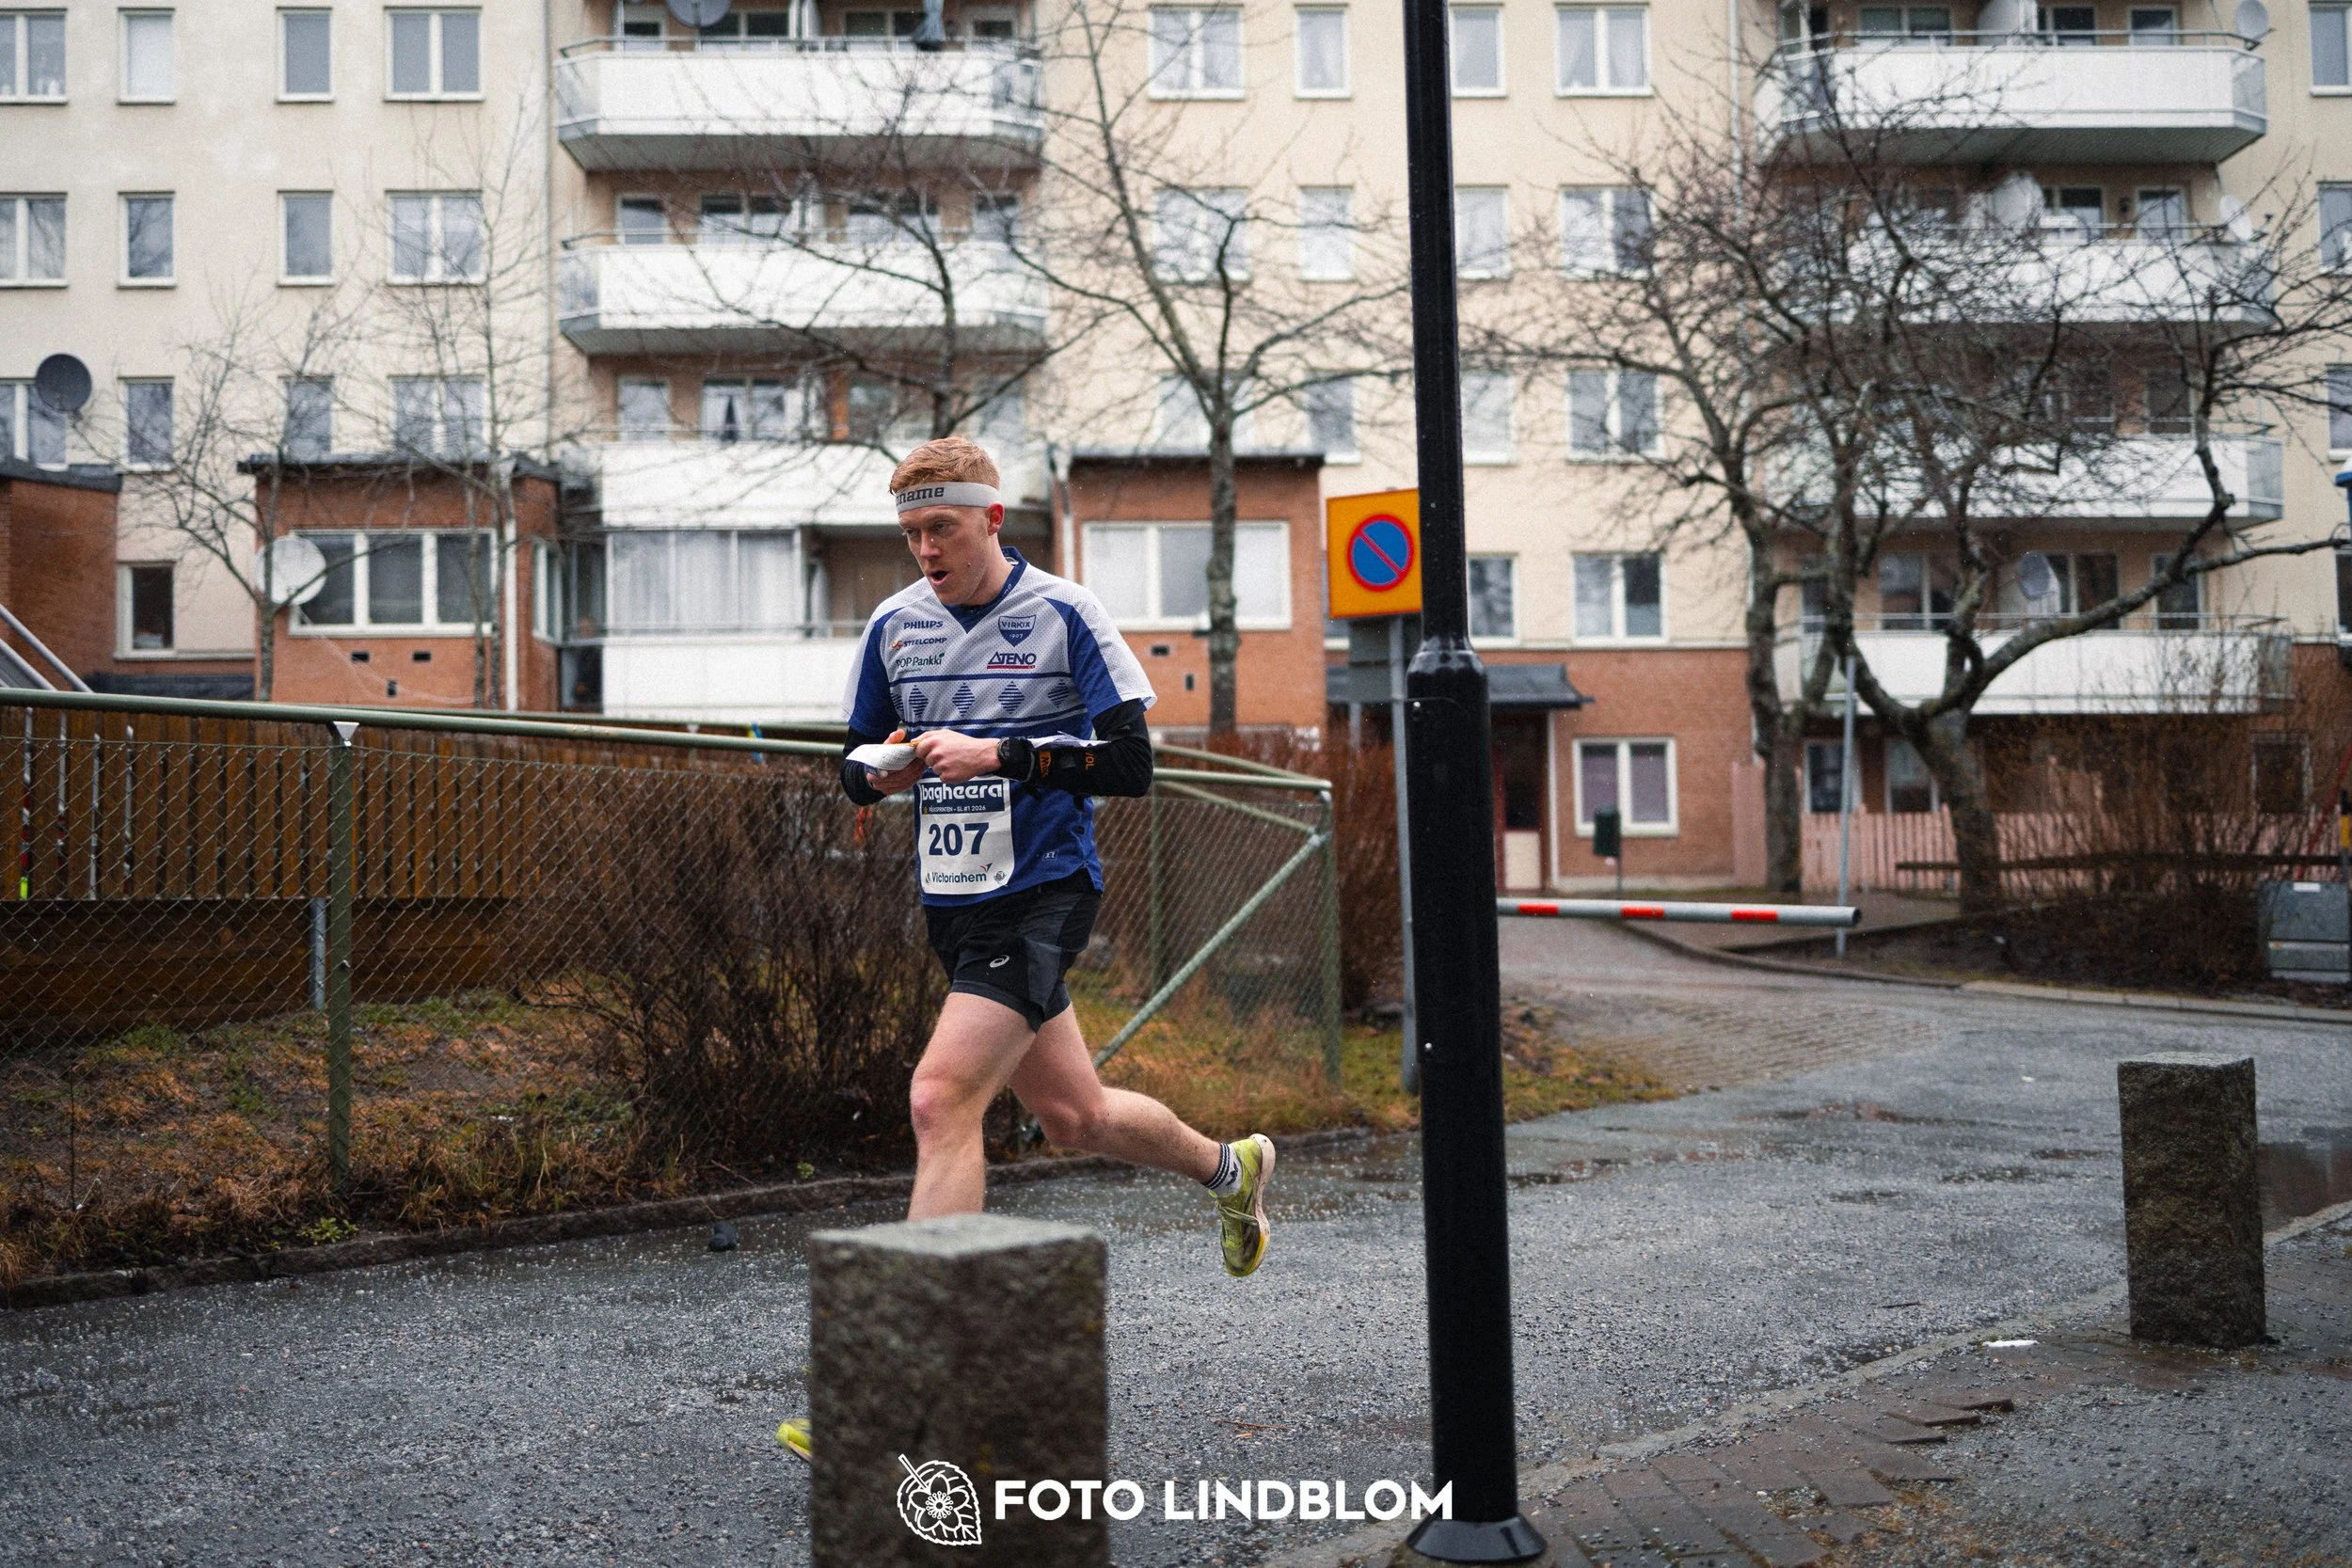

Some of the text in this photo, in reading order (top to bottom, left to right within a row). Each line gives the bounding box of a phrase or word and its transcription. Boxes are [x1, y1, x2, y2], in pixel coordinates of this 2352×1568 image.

[904, 621, 944, 629] PHILIPS
[903, 638, 947, 647] STEELCOMP
[913, 653, 945, 666] Pankki
[988, 651, 1037, 665] ATENO
[922, 784, 1003, 803] bagheera
[929, 822, 990, 856] 207
[932, 872, 987, 883] Victoriahem
